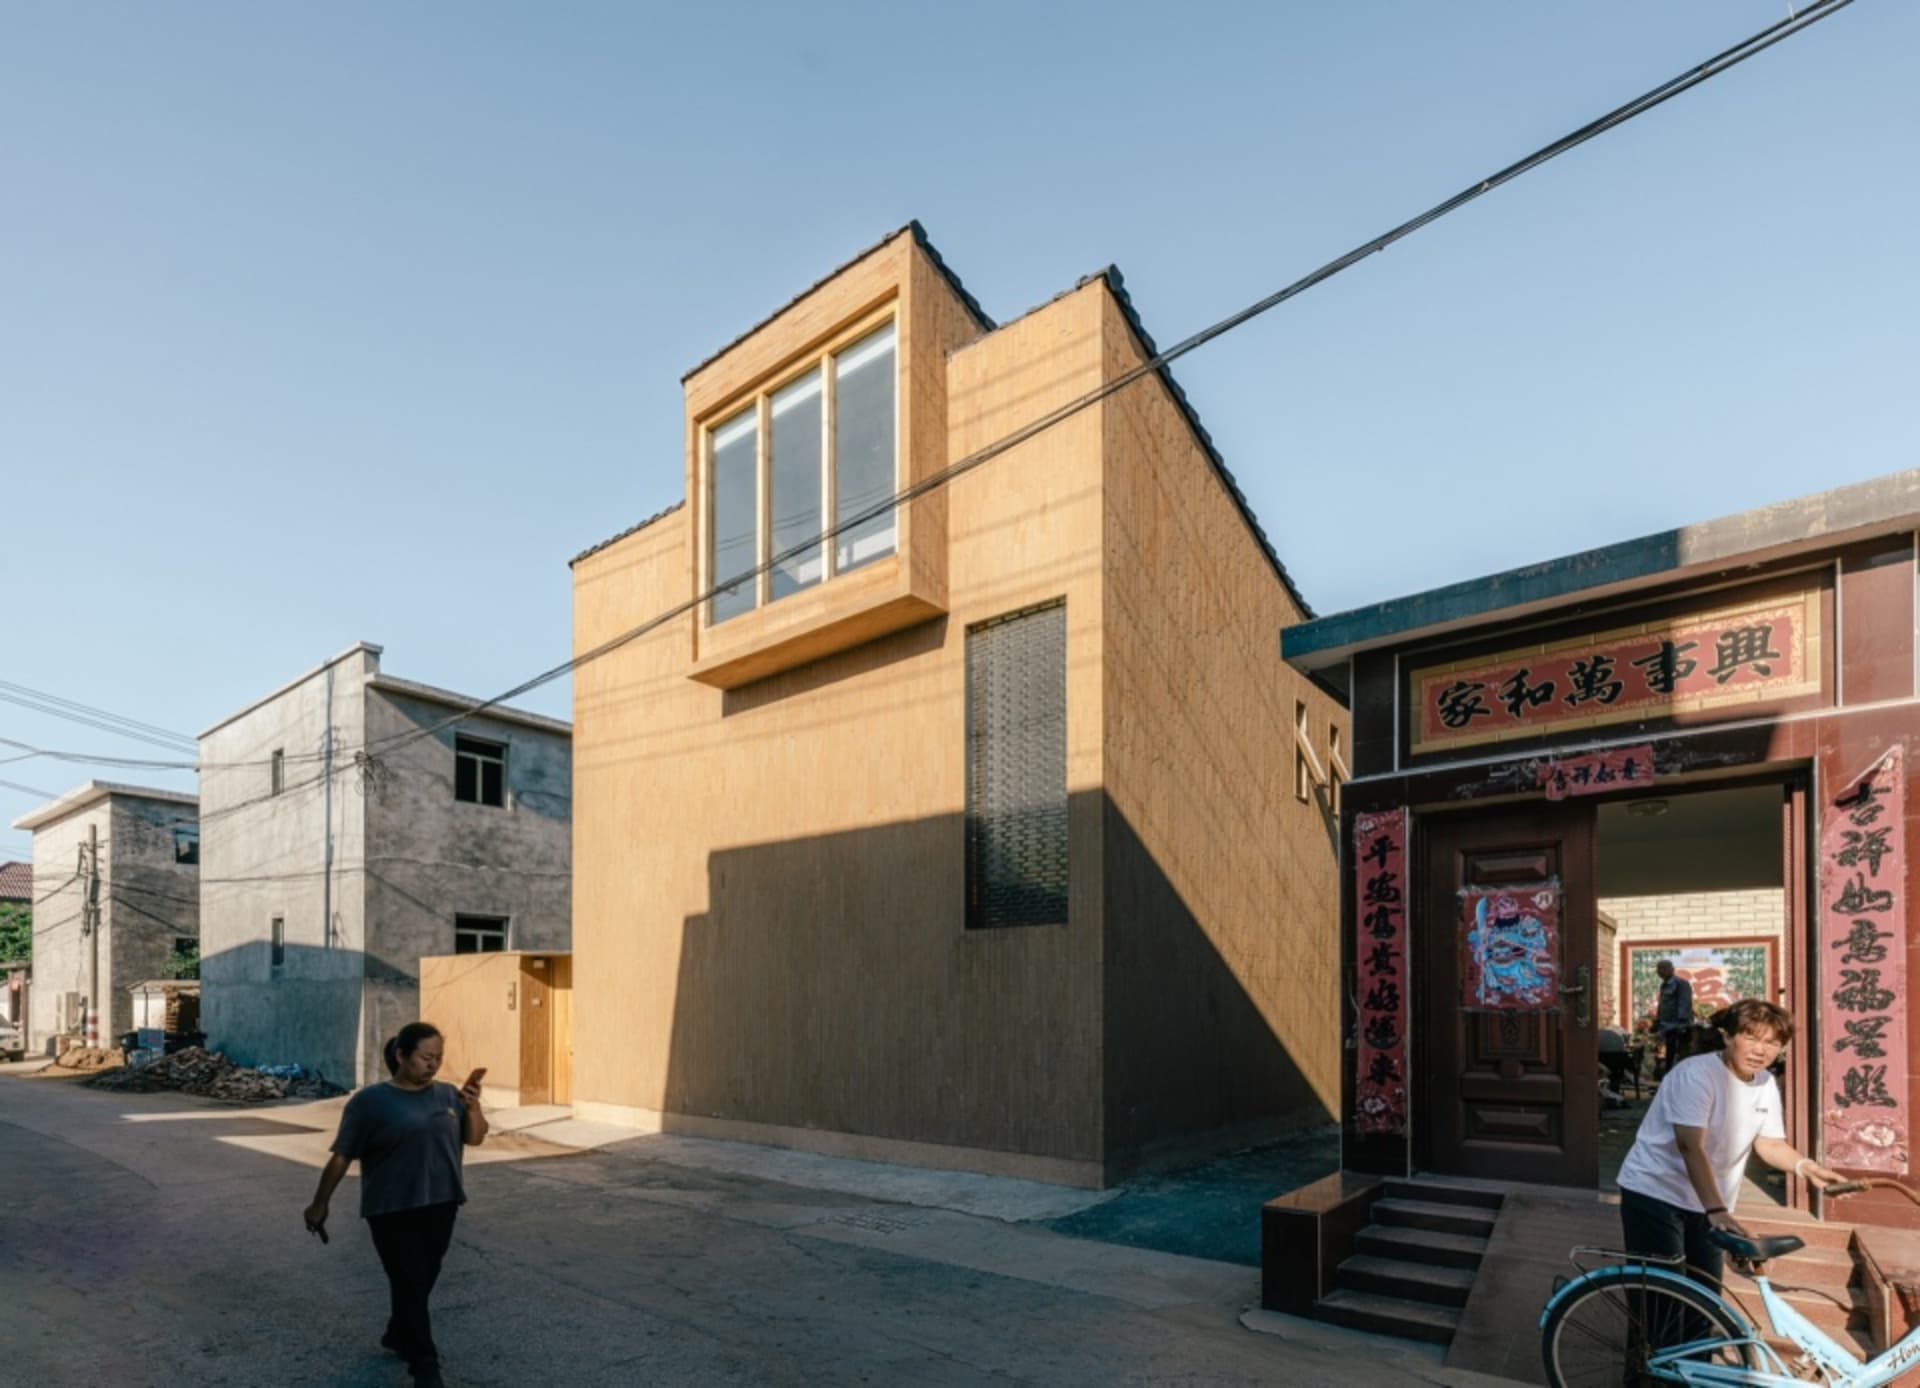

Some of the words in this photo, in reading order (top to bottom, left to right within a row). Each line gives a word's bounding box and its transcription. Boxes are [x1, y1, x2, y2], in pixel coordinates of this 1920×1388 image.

[1438, 624, 1781, 728] 家和萬事興
[1832, 781, 1897, 1108] 吉祥如意福星照
